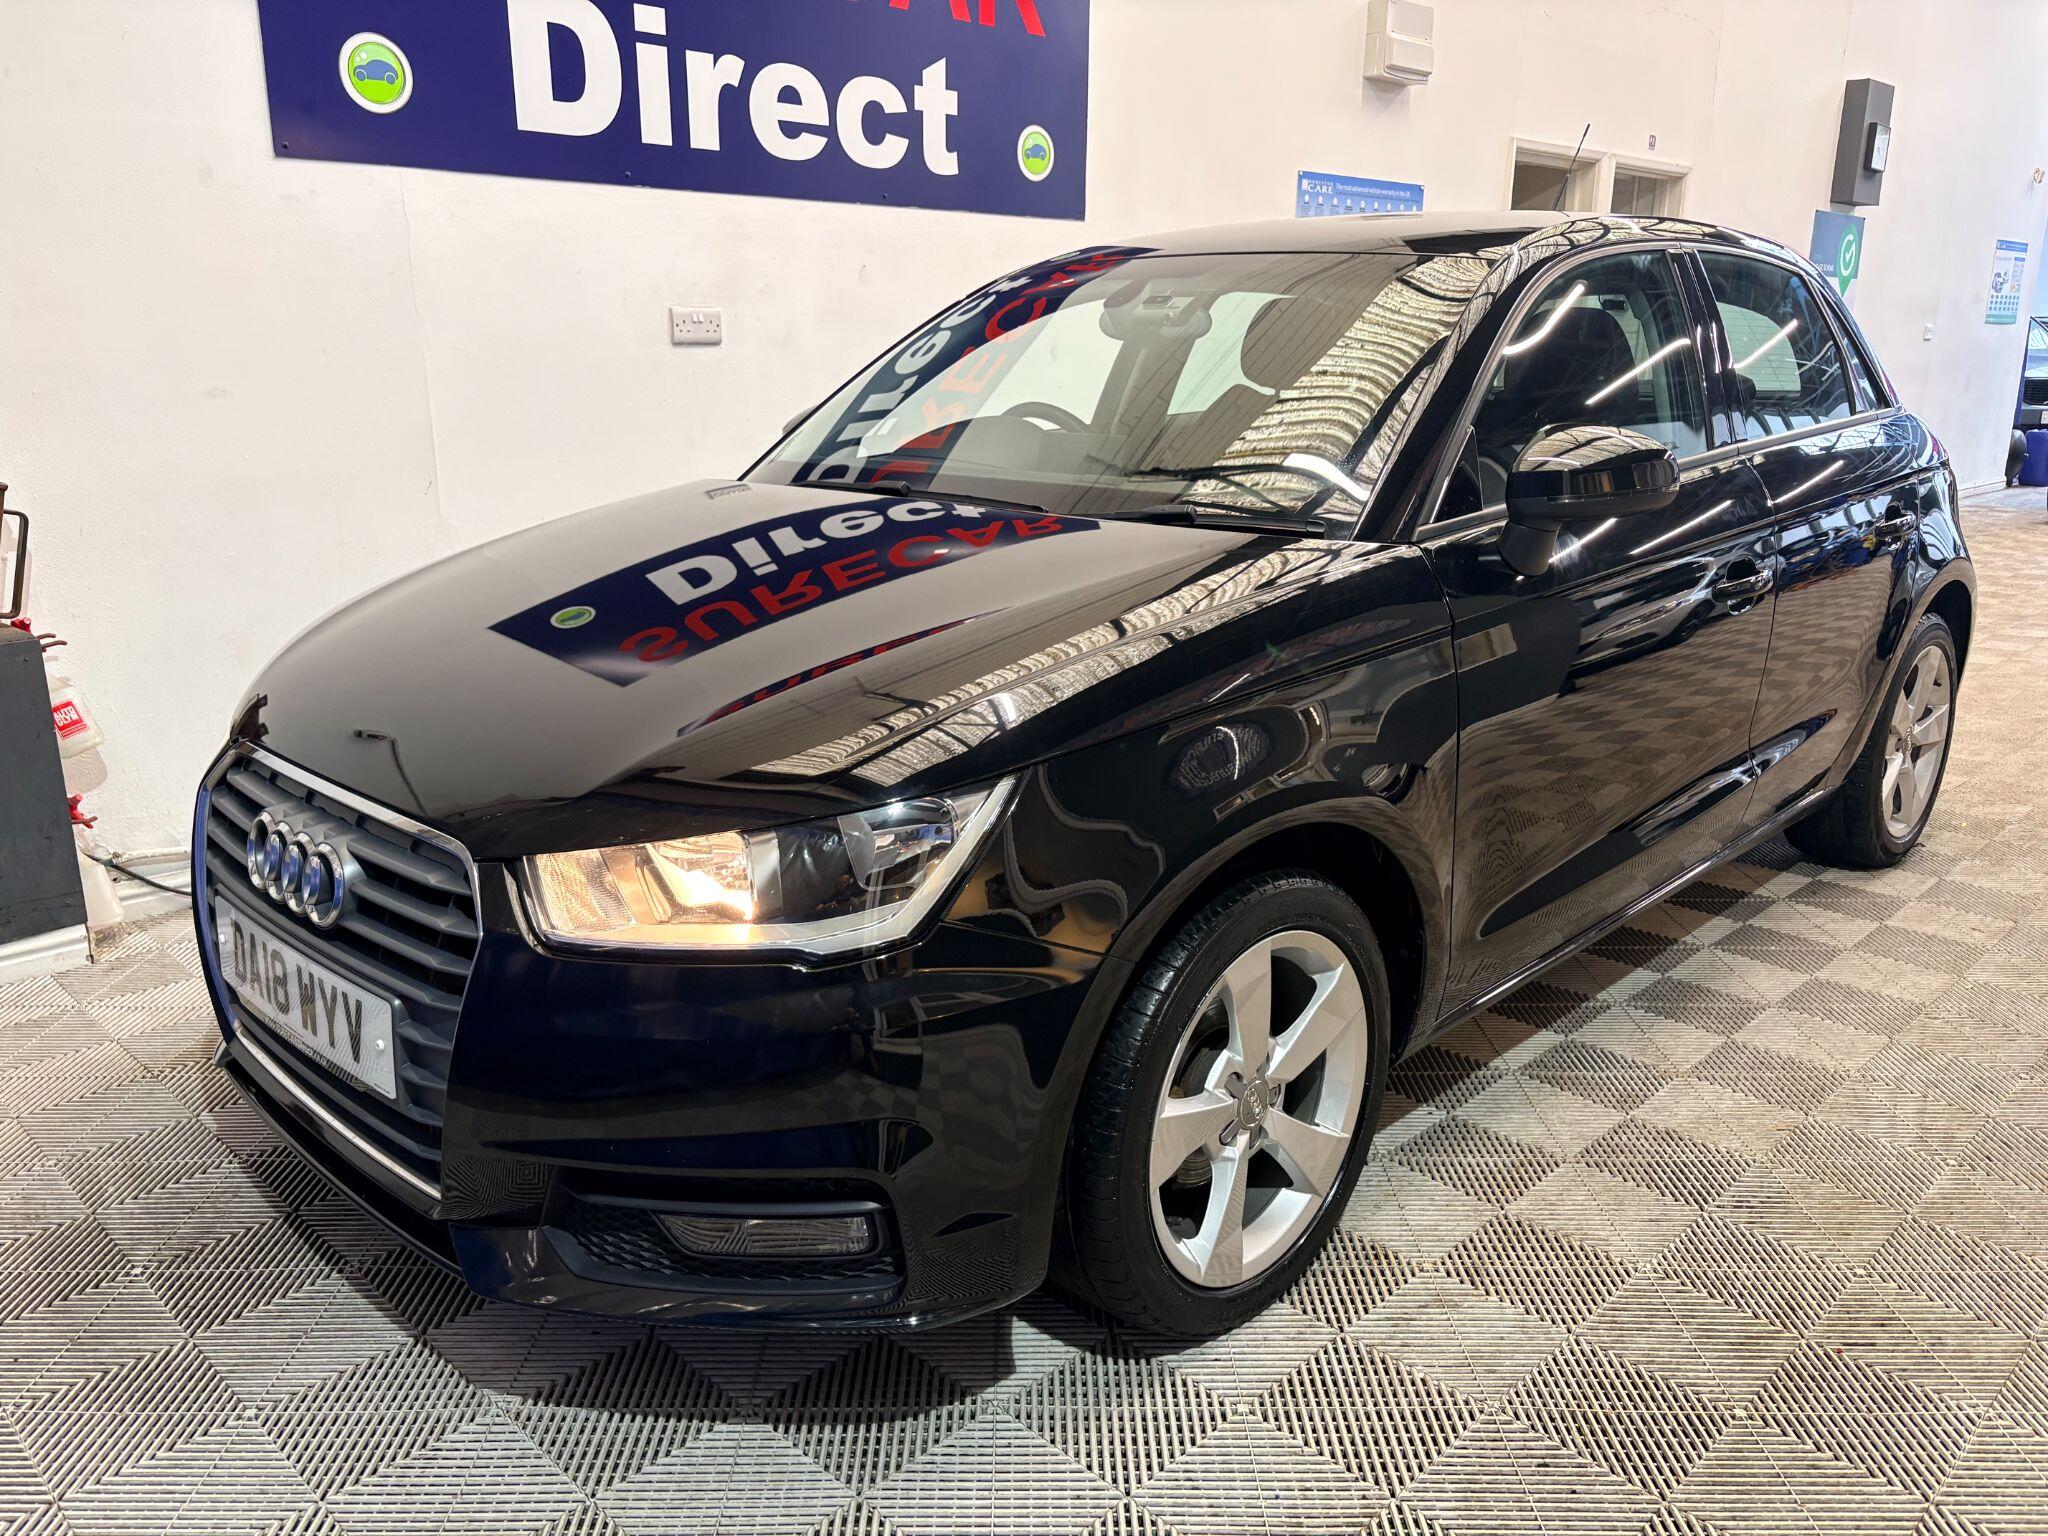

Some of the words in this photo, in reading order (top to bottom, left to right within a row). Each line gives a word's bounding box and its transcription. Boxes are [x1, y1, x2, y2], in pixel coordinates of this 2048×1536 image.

[507, 0, 959, 175] Direct
[1308, 183, 1334, 195] CARE
[230, 918, 290, 1016] DA18
[296, 963, 363, 1064] WYV
